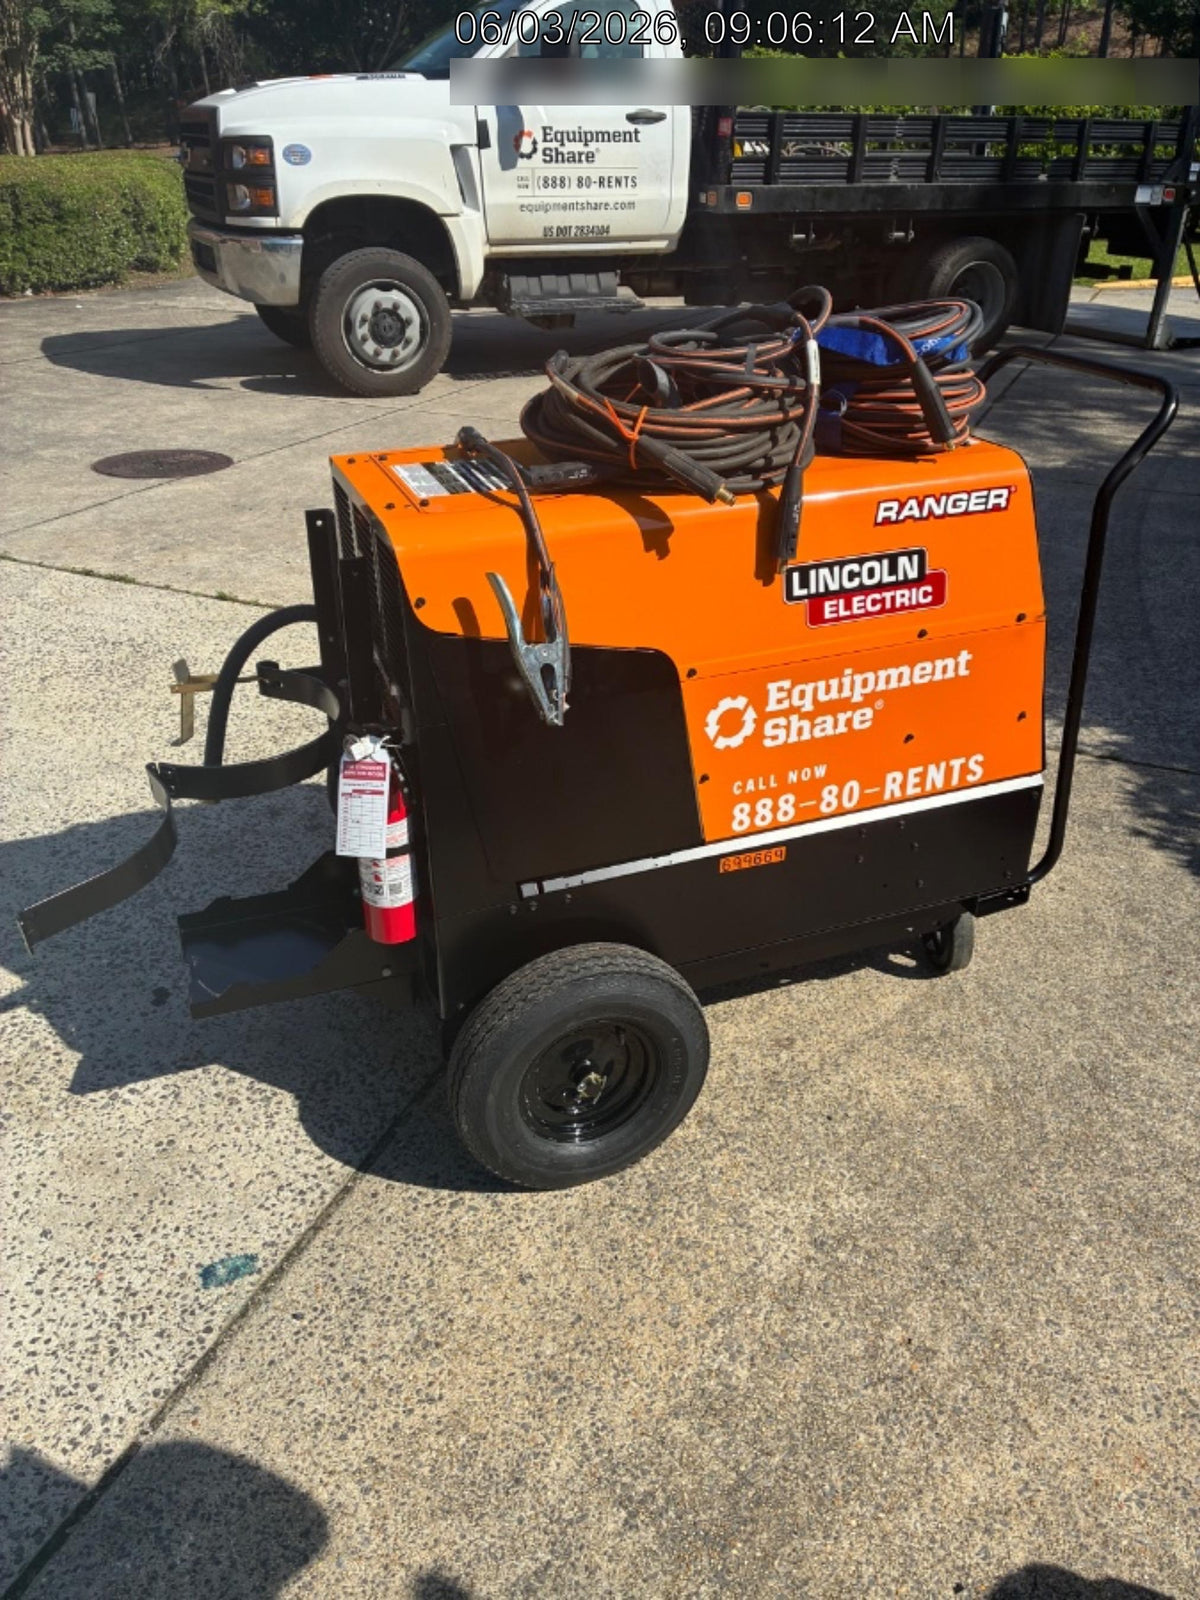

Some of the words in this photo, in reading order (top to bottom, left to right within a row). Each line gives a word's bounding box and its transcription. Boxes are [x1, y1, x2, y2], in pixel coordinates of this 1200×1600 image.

[541, 126, 641, 147] Equipment
[537, 175, 572, 190] (888)
[576, 175, 638, 190] 80-RENTS
[519, 200, 636, 214] equipmentshare.com
[543, 226, 554, 237] US
[556, 225, 573, 237] DOT
[876, 488, 1010, 524] RANGER
[791, 554, 919, 597] LINCOLN
[823, 584, 934, 620] ELECTRIC
[765, 649, 973, 713] Equipment
[732, 776, 779, 796] CALL
[787, 763, 828, 785] NOW
